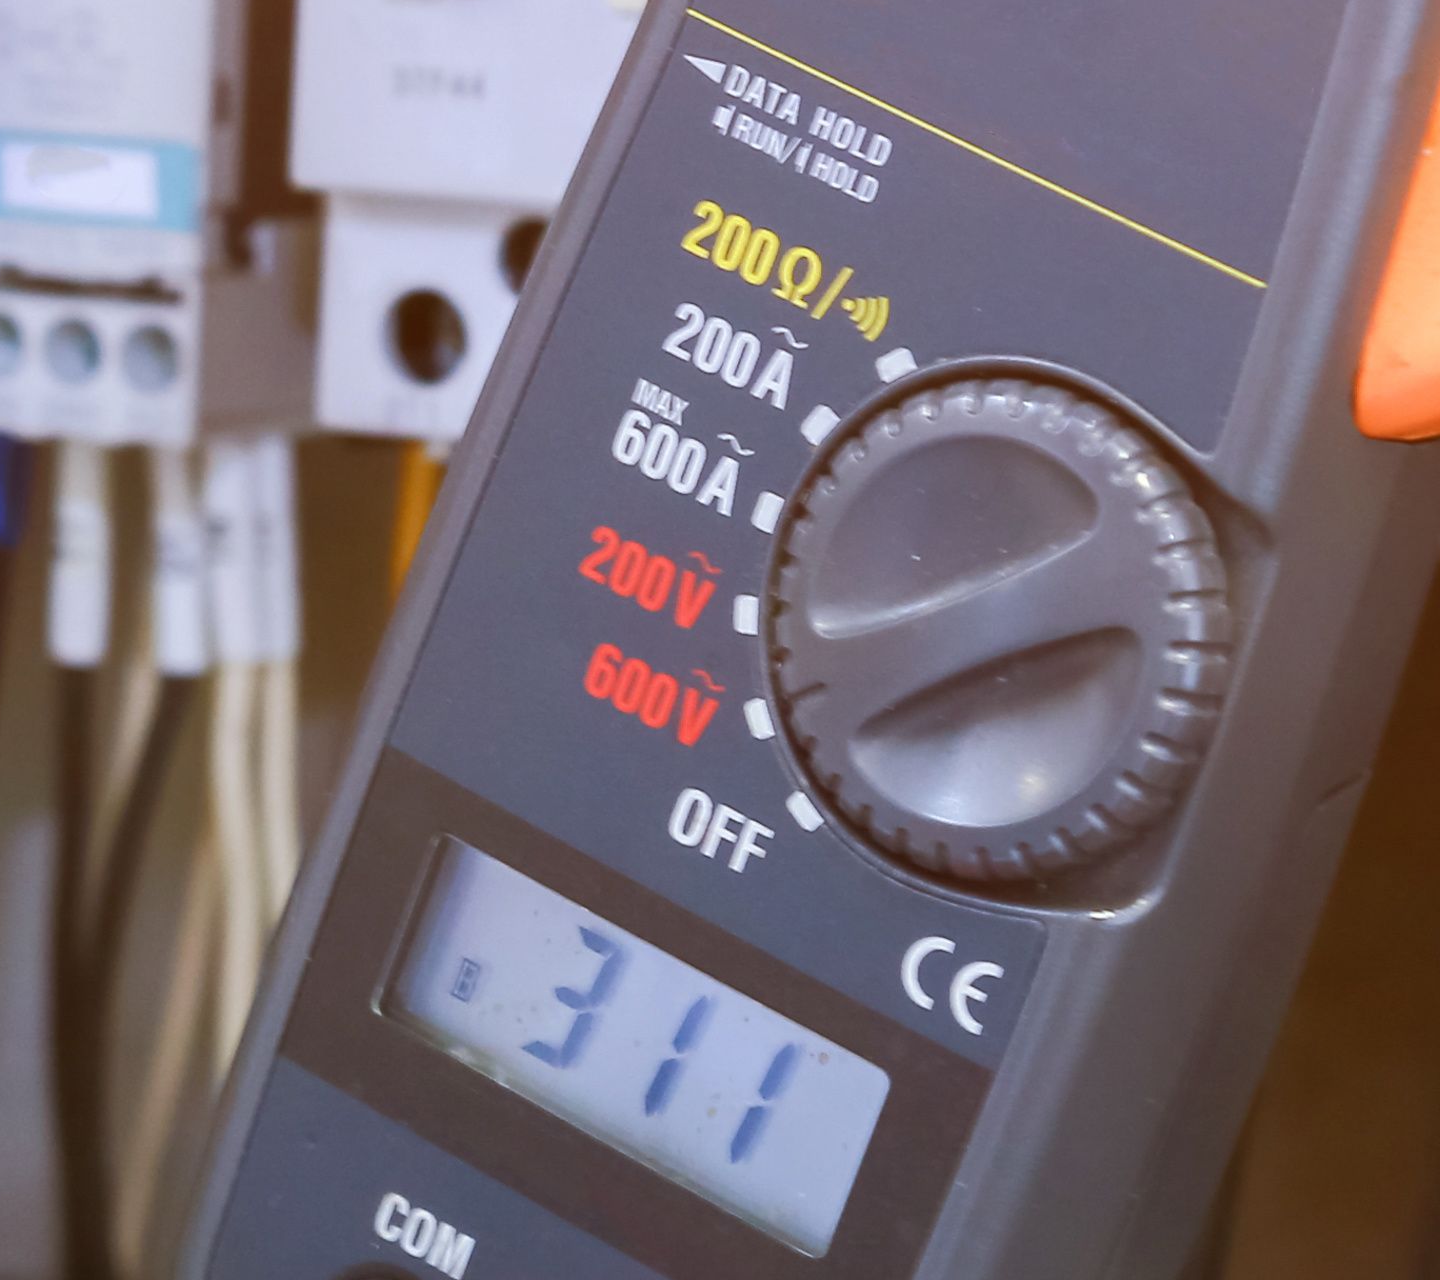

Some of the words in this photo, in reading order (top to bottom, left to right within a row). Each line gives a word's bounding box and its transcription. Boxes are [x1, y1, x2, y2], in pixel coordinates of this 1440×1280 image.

[723, 64, 802, 125] DATA
[808, 106, 893, 167] HOLD
[730, 112, 803, 165] RUN/
[808, 152, 880, 204] HOLD
[631, 378, 690, 426] MAX
[667, 786, 777, 874] OFF
[900, 935, 1006, 1036] CE
[521, 925, 807, 1165] 311
